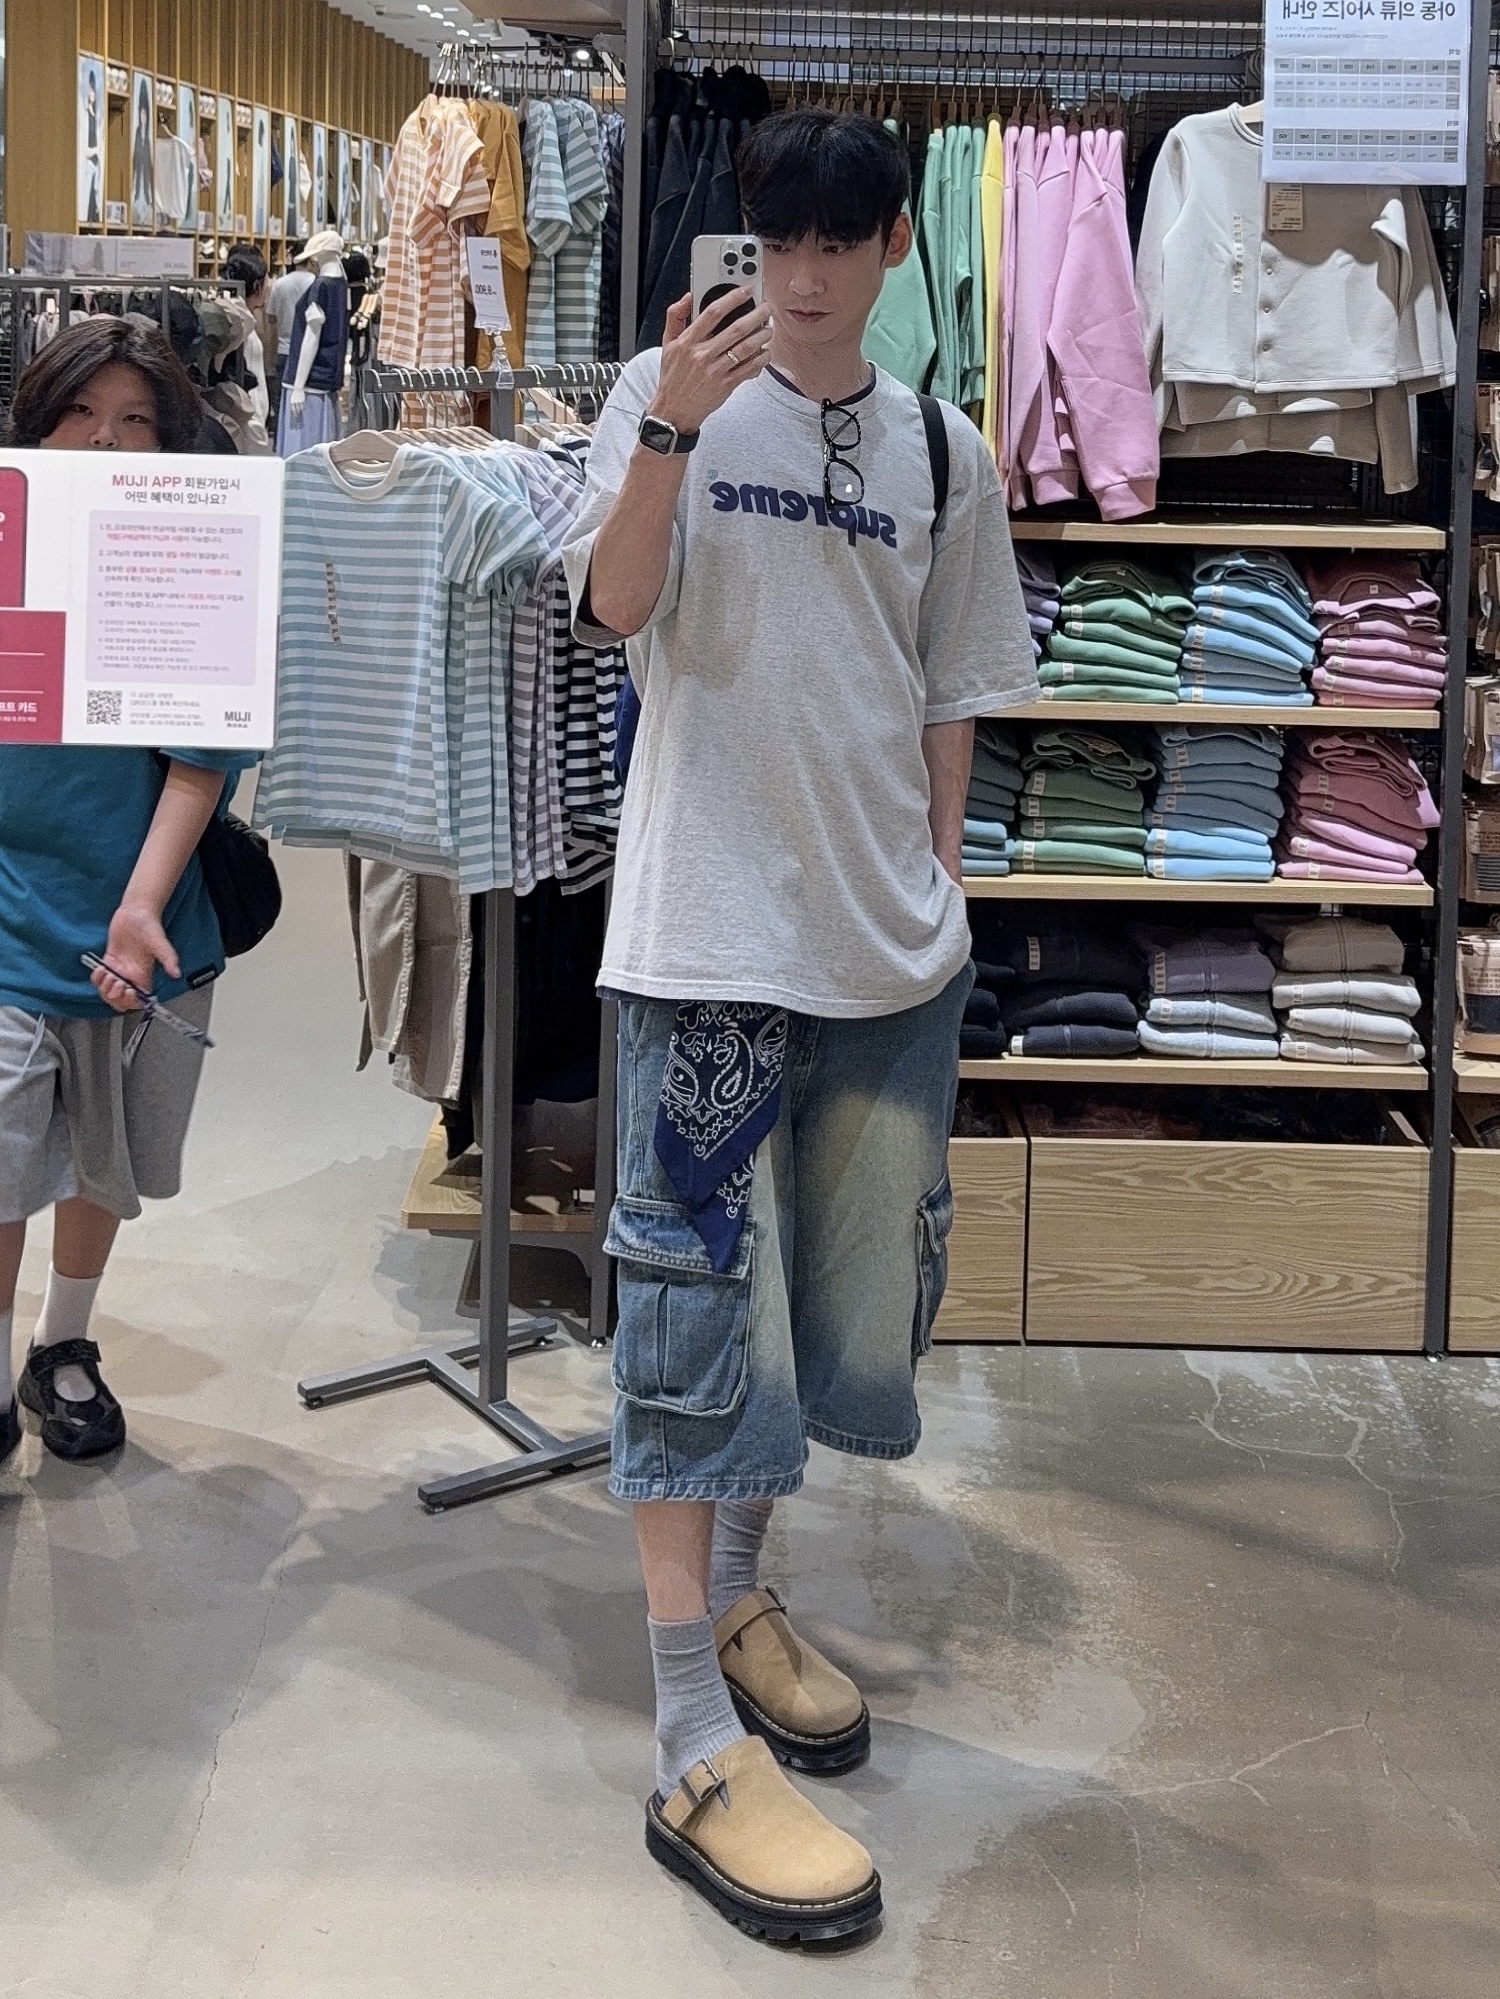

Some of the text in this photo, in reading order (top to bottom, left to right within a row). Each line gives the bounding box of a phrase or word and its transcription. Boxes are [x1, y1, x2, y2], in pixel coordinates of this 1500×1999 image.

[112, 475, 240, 491] MUJI APP 회원가입시
[125, 491, 227, 504] 어떤 혜택이 있나요?
[18, 702, 38, 713] 카드
[225, 711, 251, 722] MUJI
